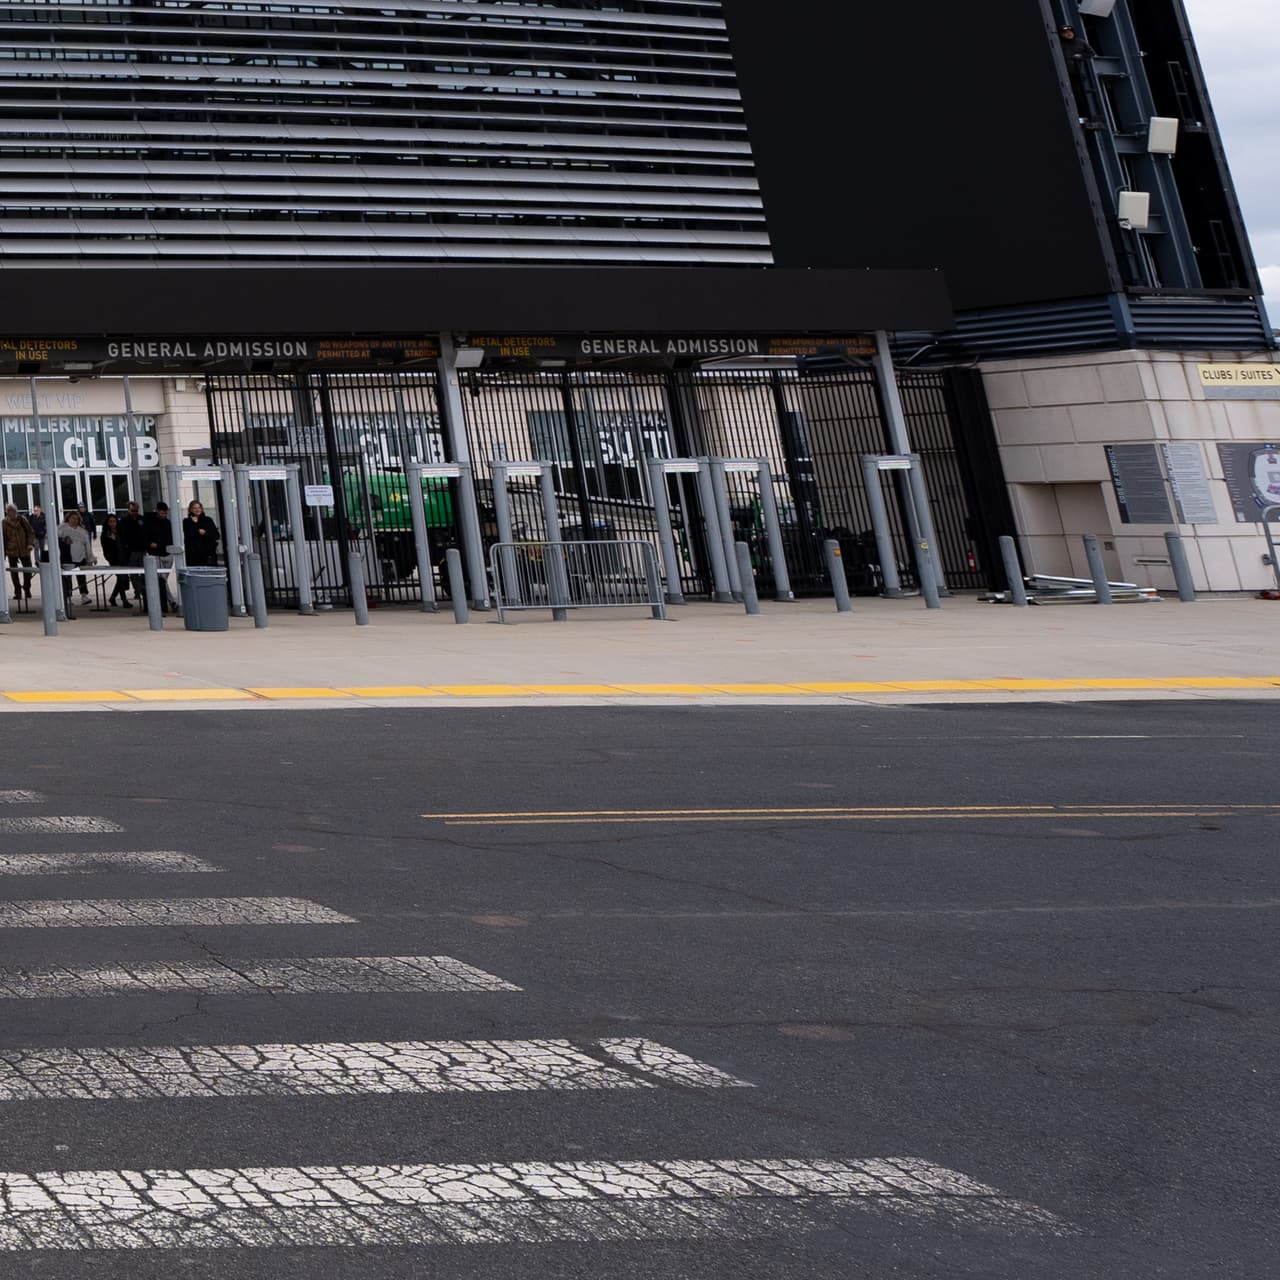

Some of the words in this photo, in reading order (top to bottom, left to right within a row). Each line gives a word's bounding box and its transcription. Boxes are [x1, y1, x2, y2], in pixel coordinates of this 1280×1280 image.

[20, 340, 78, 350] DETECTORS
[472, 337, 501, 346] METAL
[504, 337, 556, 346] DETECTORS
[581, 340, 660, 354] GENERAL
[666, 339, 759, 353] ADMISSION
[108, 342, 197, 358] GENERAL
[204, 341, 308, 357] ADMISSION
[500, 347, 510, 356] IN
[512, 347, 531, 356] USE
[15, 351, 26, 361] IN
[28, 351, 49, 361] USE
[1202, 370, 1233, 380] CLUBS
[1241, 370, 1273, 380] SUITES
[6, 393, 53, 410] WET
[5, 417, 71, 433] MILLER
[76, 417, 113, 432] LITE
[63, 436, 159, 468] CLUB
